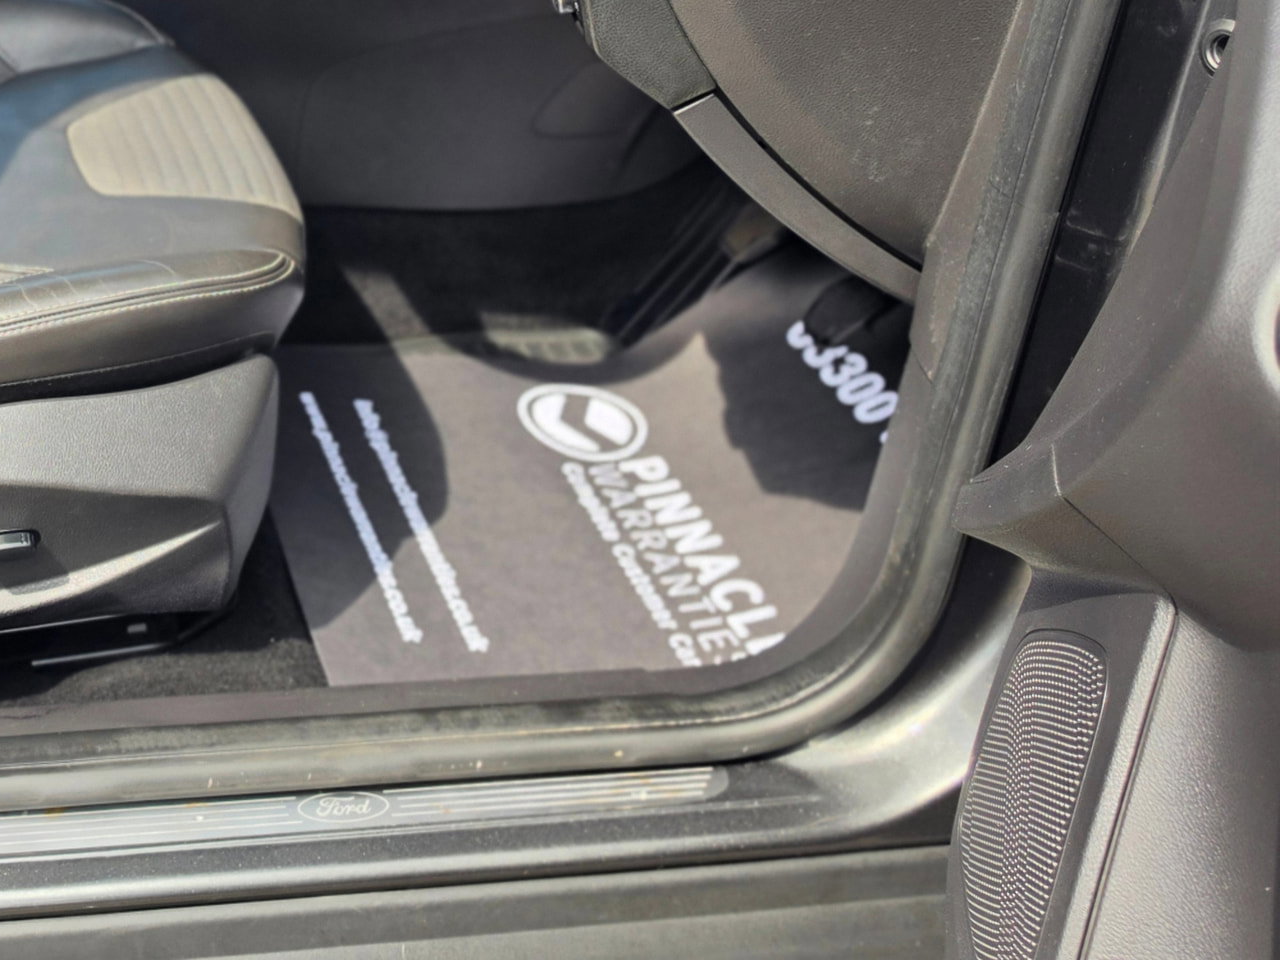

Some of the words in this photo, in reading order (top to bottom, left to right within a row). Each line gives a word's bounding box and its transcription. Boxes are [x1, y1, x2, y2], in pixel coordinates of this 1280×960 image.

[560, 461, 620, 542] Complete
[611, 542, 678, 631] Customer
[315, 795, 372, 817] Ford
